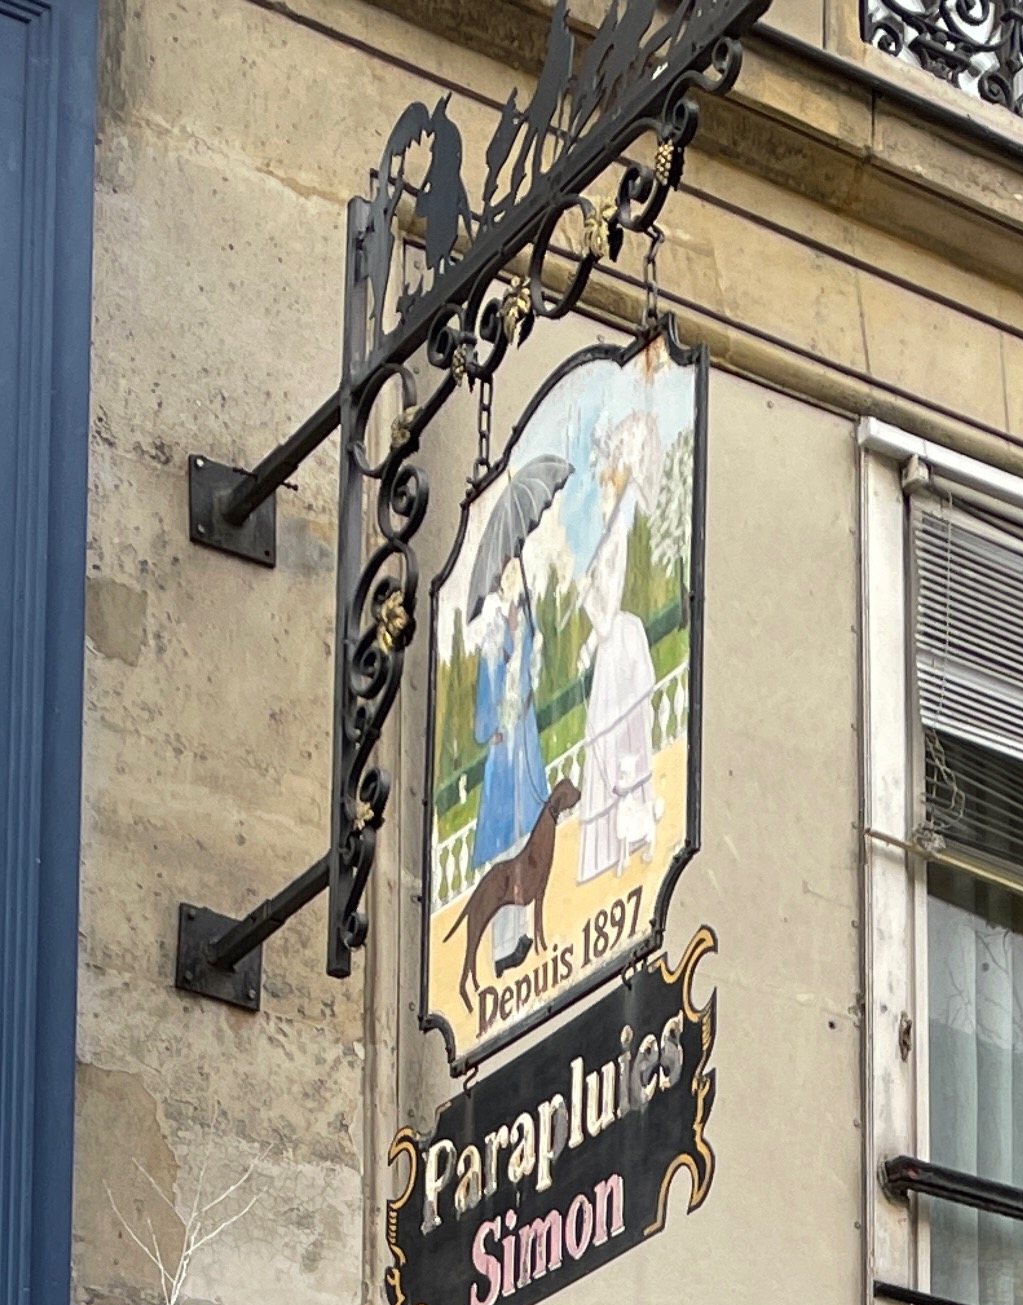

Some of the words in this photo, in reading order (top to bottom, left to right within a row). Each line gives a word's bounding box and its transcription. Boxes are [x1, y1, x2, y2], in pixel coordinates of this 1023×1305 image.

[475, 944, 573, 1037] Depuis
[580, 886, 644, 970] 1897
[420, 1010, 684, 1235] Parapluies
